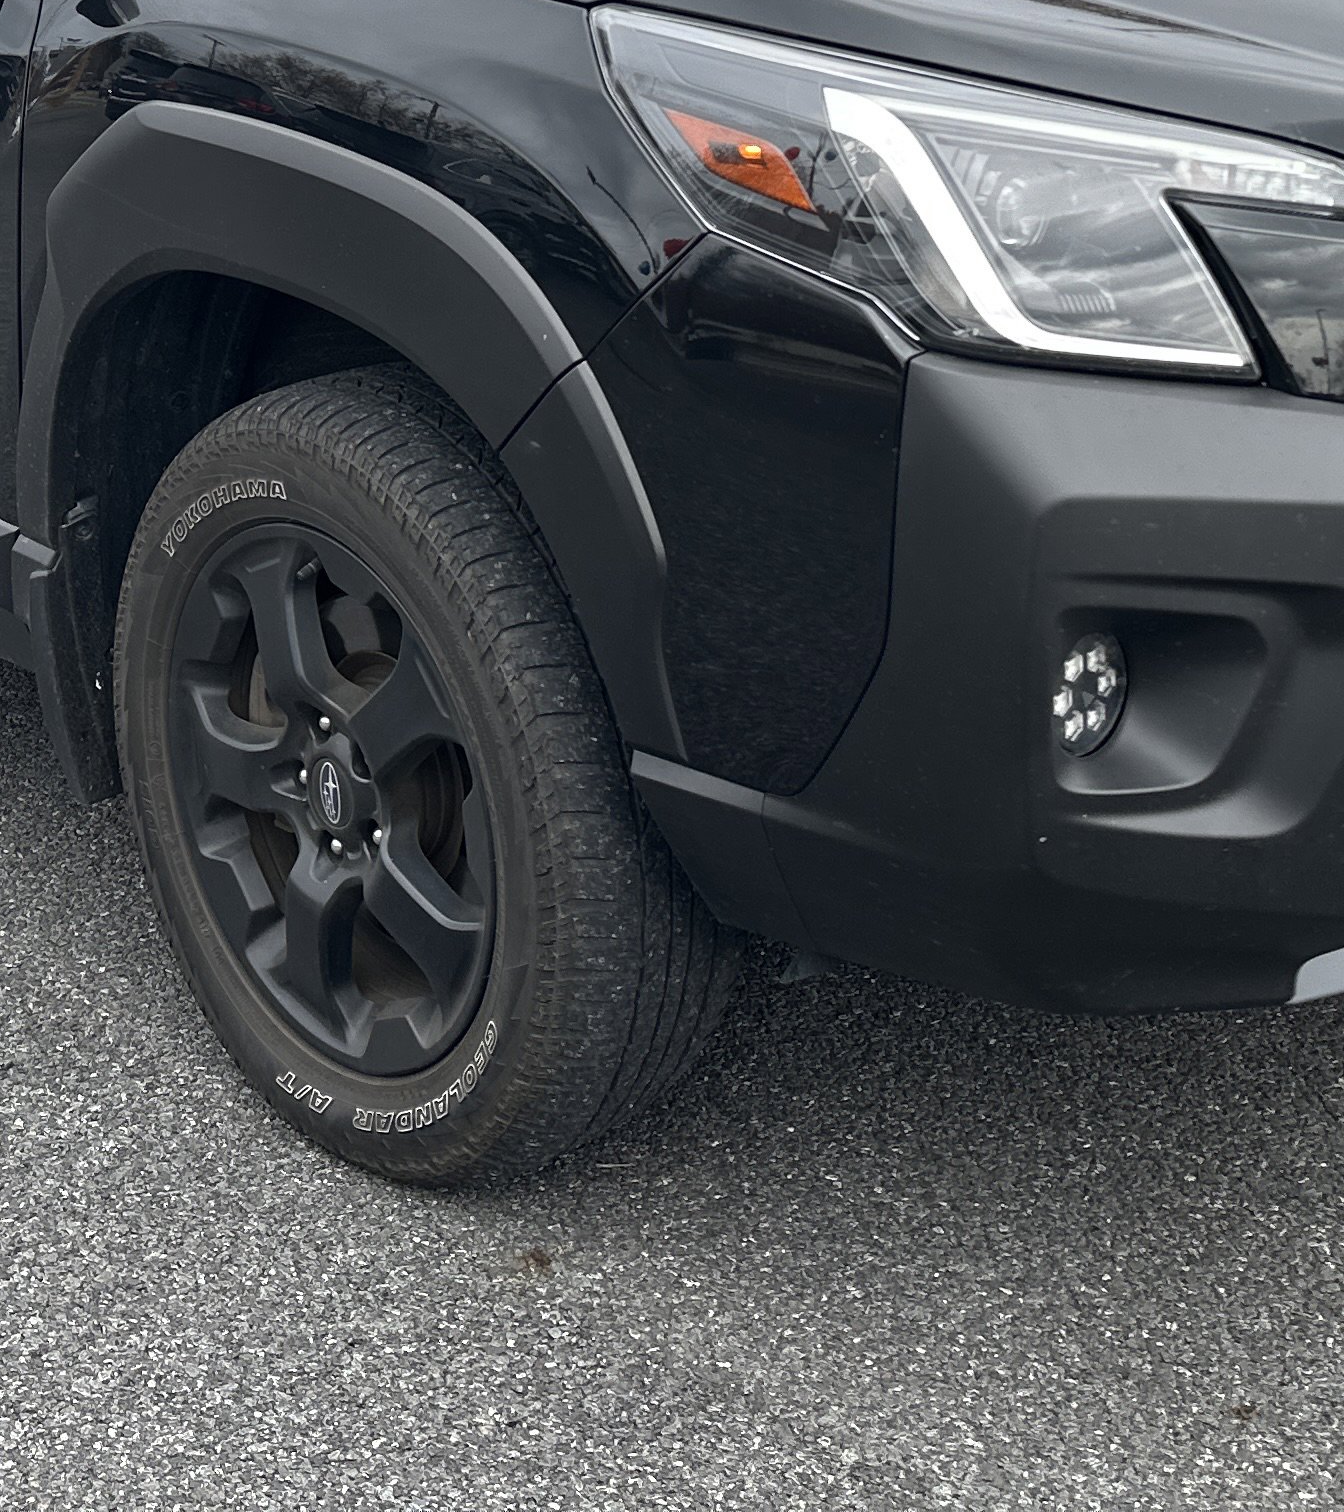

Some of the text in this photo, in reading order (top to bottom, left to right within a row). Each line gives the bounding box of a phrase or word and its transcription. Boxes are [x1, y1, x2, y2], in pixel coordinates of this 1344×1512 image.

[160, 478, 287, 558] YOKOHAMA
[275, 1020, 499, 1133] GEOLANDAR A/T
